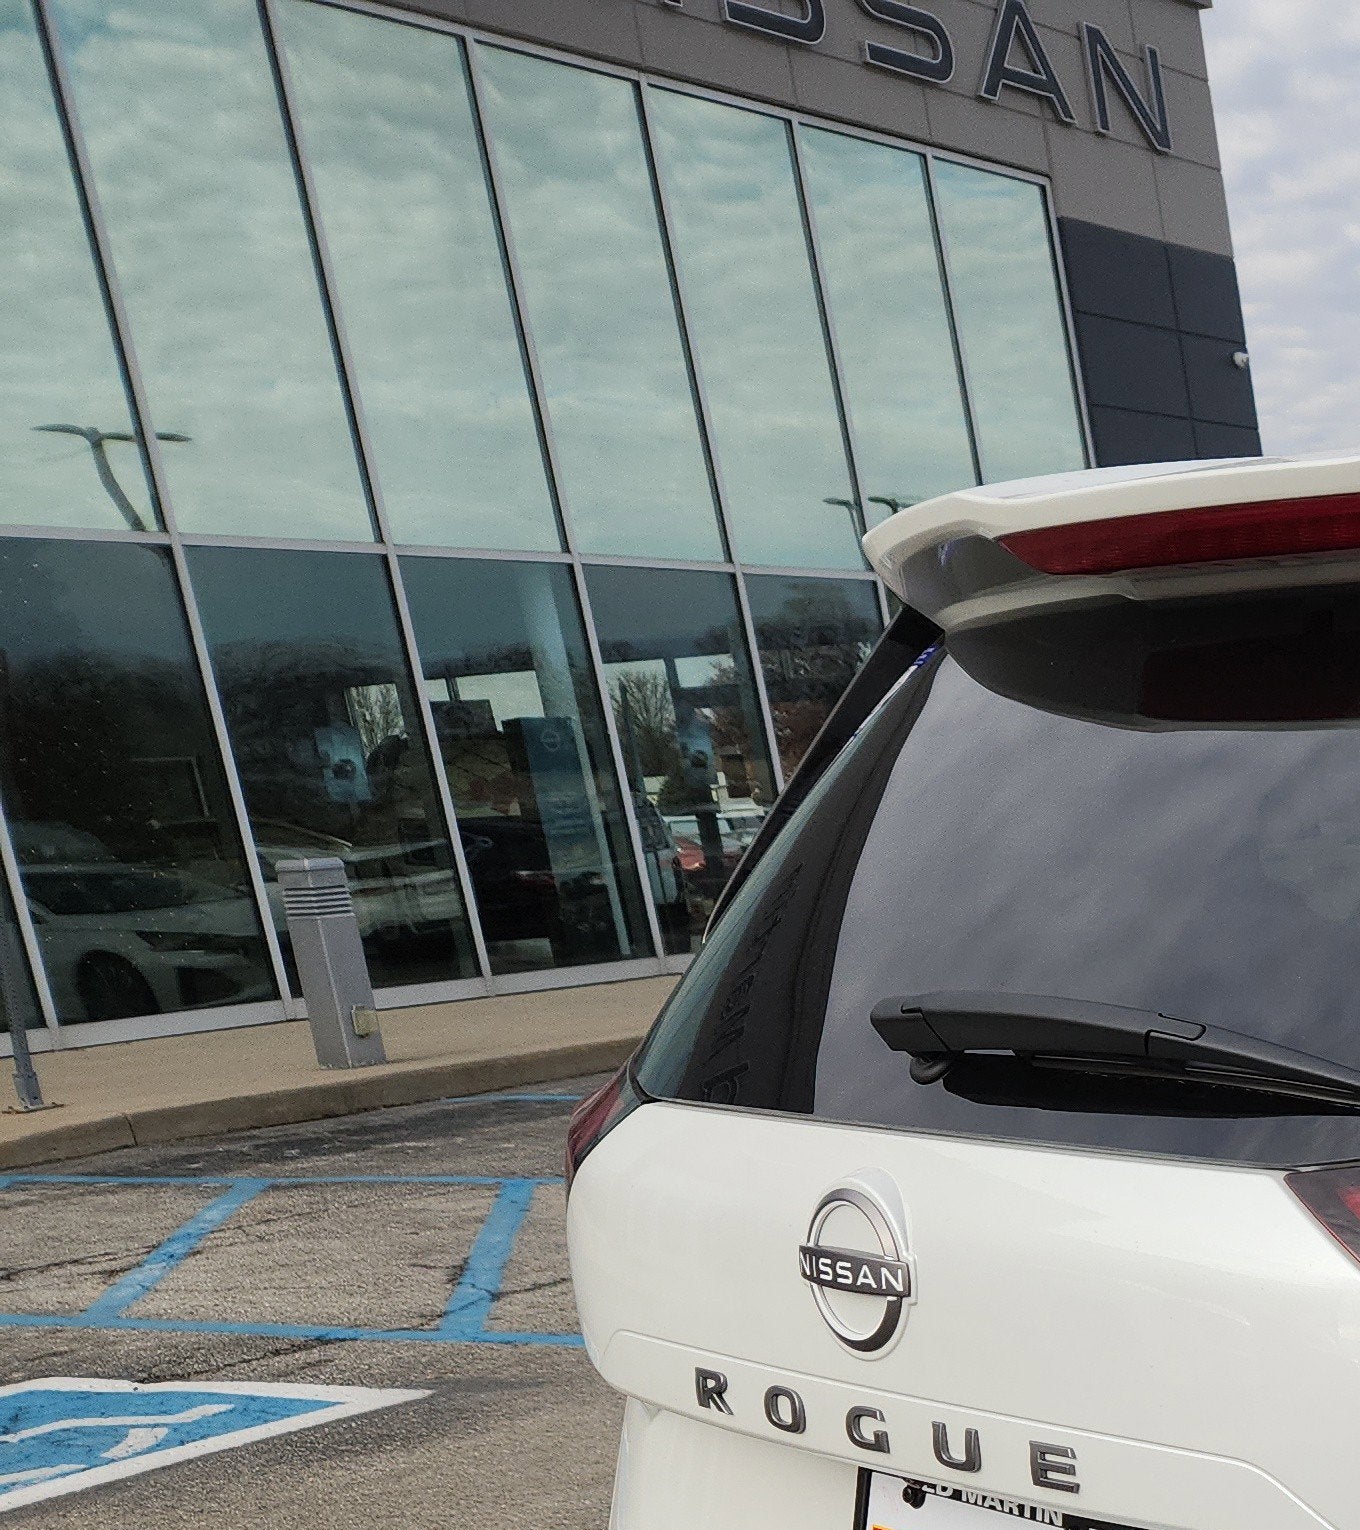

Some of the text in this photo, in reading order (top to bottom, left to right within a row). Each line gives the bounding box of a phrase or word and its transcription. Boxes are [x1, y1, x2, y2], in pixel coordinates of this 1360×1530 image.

[799, 1250, 904, 1293] NISSAN
[694, 1366, 1082, 1496] ROGUE
[960, 1487, 1064, 1528] MARTIN
